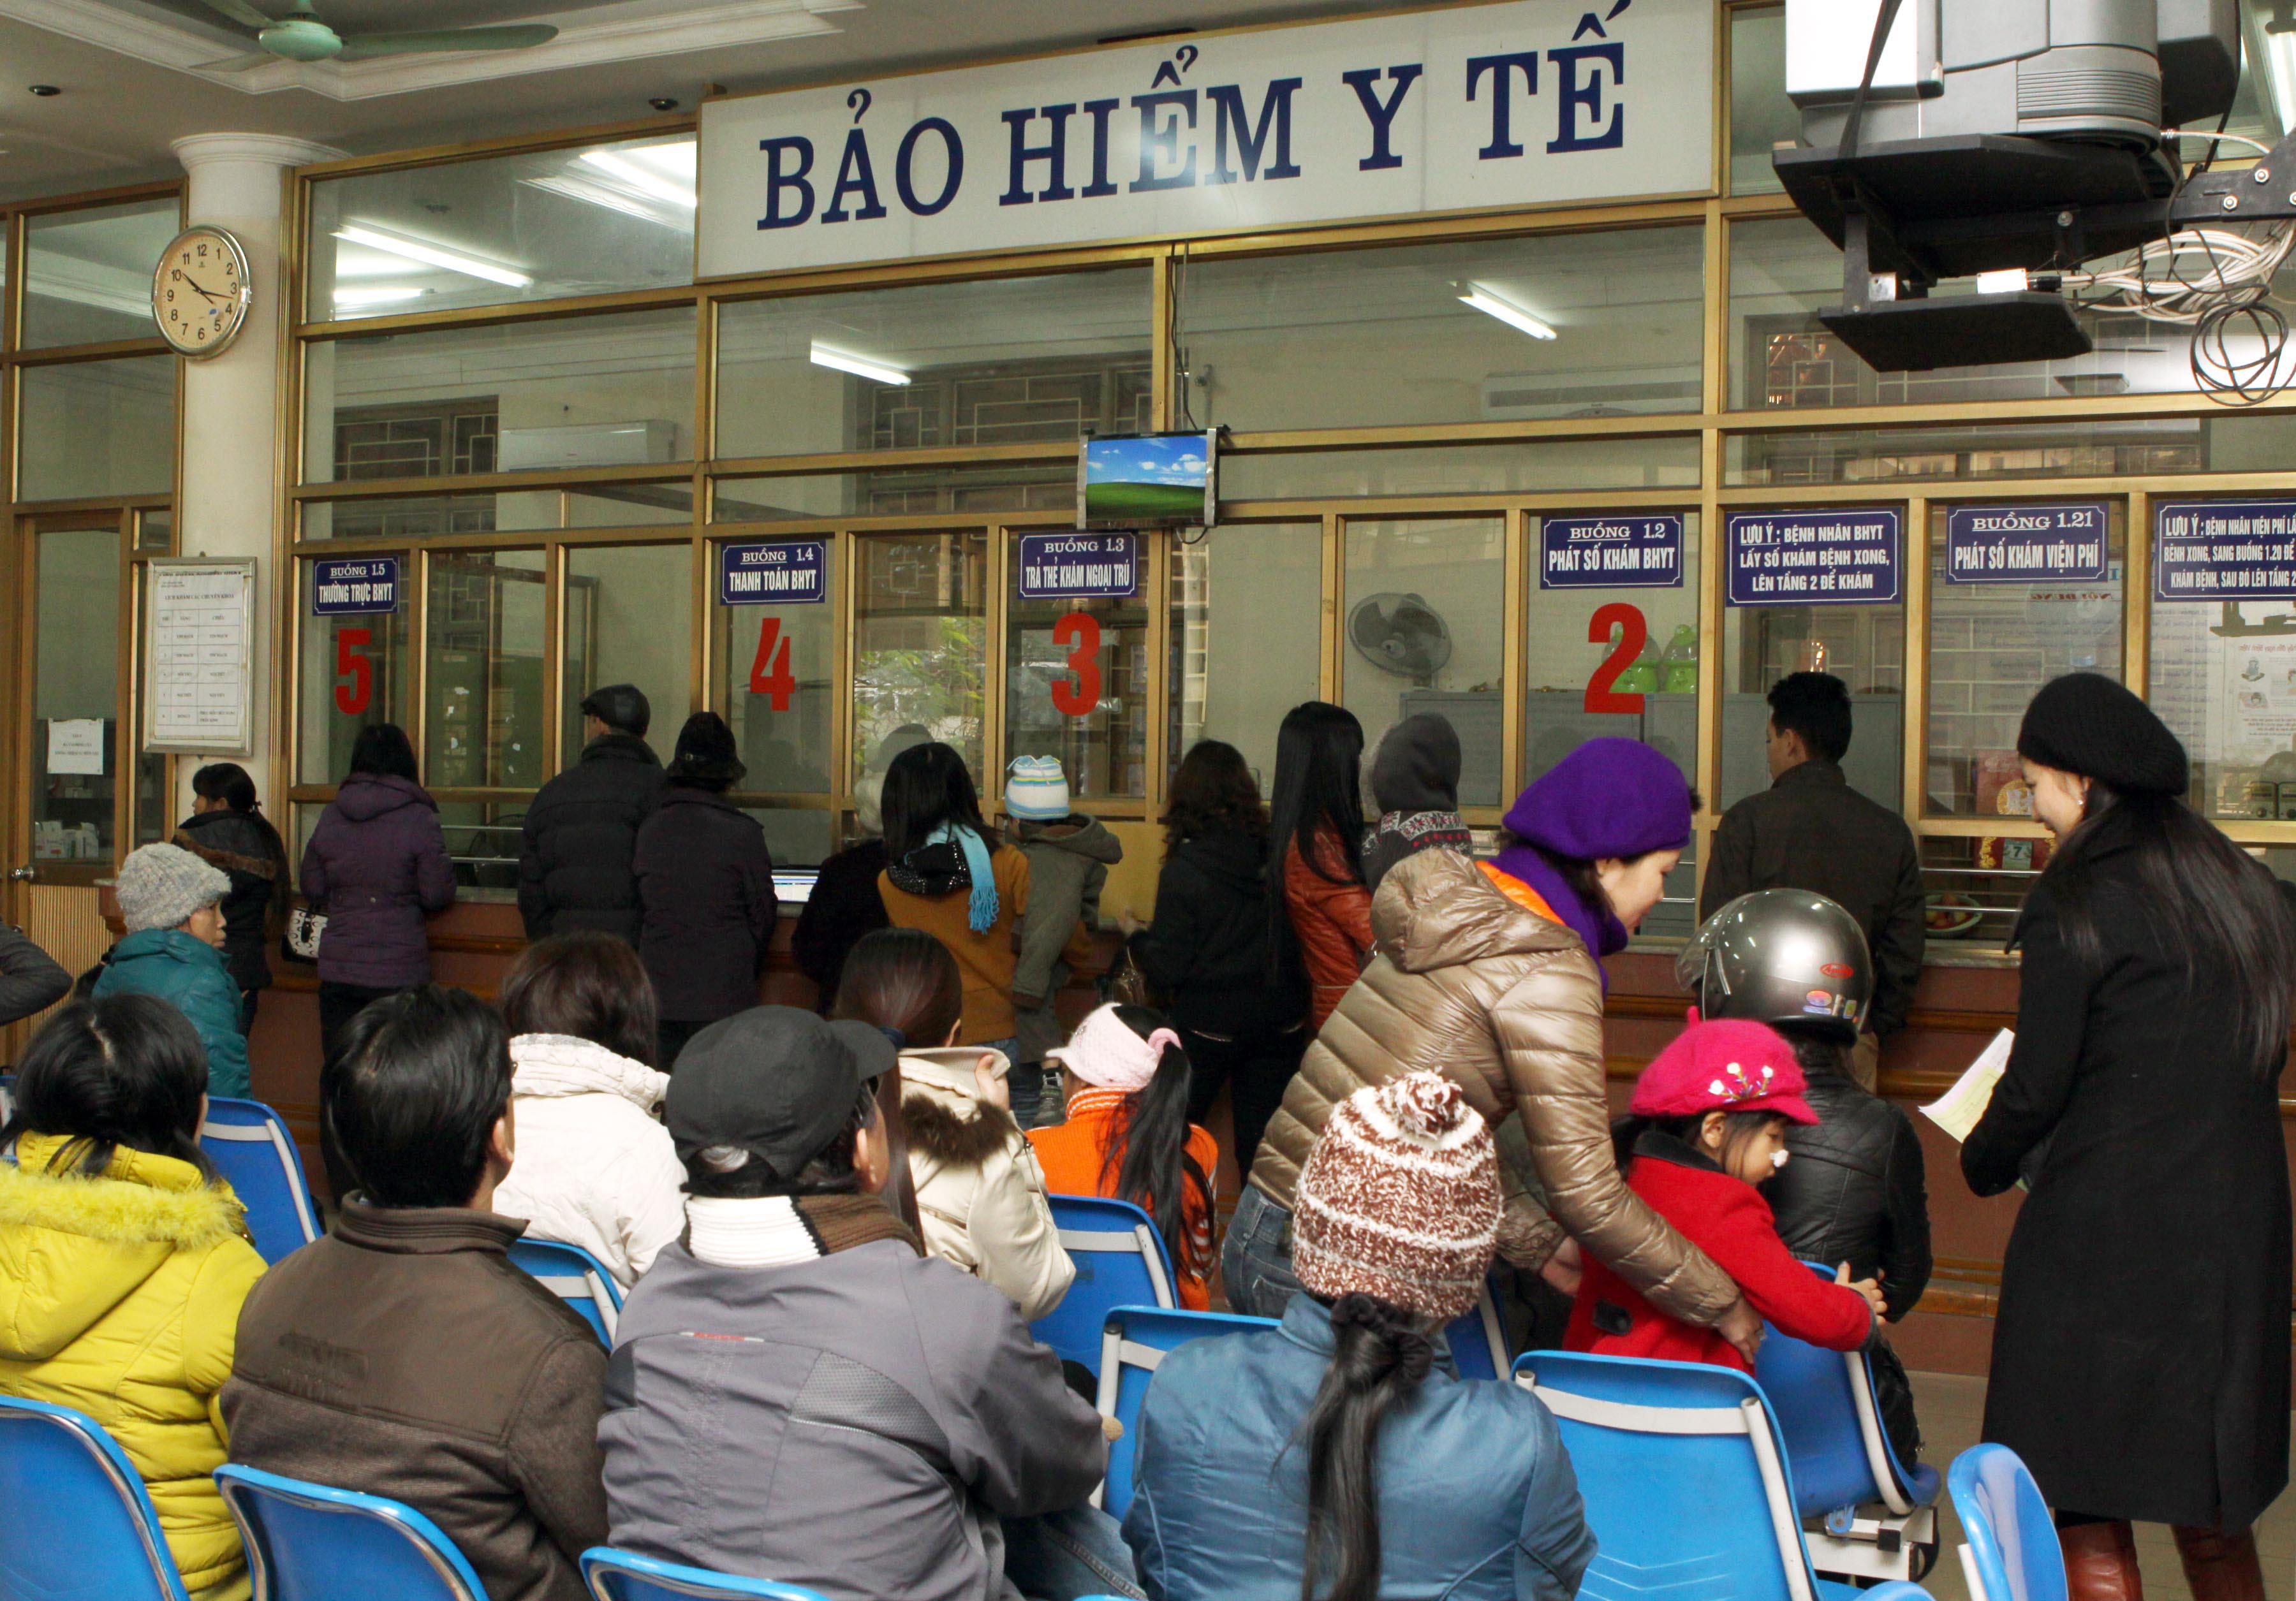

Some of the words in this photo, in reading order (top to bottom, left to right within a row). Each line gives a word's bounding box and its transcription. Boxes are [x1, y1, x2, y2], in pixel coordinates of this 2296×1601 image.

[757, 89, 964, 230] BẢO
[999, 45, 1302, 206] HIỂM
[1343, 63, 1423, 172] Y
[1466, 0, 1631, 160] TẾ
[182, 253, 190, 265] 11
[197, 244, 207, 256] 12
[216, 248, 220, 260] 1
[172, 269, 182, 281] 10
[226, 263, 233, 275] 2
[167, 289, 174, 302] 9
[230, 282, 237, 294] 3
[171, 309, 178, 321] 8
[225, 303, 232, 314] 4
[182, 323, 188, 335] 7
[198, 328, 205, 339] 6
[214, 319, 221, 332] 5
[1972, 511, 2051, 530] BUỒNG
[2057, 511, 2093, 527] 1.21
[2165, 515, 2189, 536] LƯU
[2205, 516, 2226, 539] BỆNH
[2228, 516, 2250, 535] NHÂN
[2252, 515, 2270, 539] VIỆN
[2272, 515, 2286, 534] PHÍ
[1570, 522, 1631, 539] BUỒNG
[1643, 523, 1665, 539] 1.2
[1740, 524, 1763, 545] LƯU
[1784, 525, 1815, 546] BỆNH
[1818, 523, 1851, 542] NHÂN
[1853, 525, 1883, 541] BHYT
[1044, 537, 1099, 553] BUỒNG
[1106, 537, 1124, 552] 1.3
[742, 547, 787, 562] BUỒNG
[797, 547, 814, 562] 1.4
[1549, 545, 1580, 571] PHÁT
[1584, 542, 1601, 571] SỐ
[1603, 544, 1640, 570] KHÁM
[1643, 547, 1675, 569] BHYT
[1740, 548, 1762, 568] LẤY
[1764, 546, 1780, 567] SỐ
[1783, 548, 1816, 567] KHÁM
[1820, 548, 1851, 569] BỆNH
[1853, 549, 1890, 566] XONG,
[1955, 541, 1986, 570] PHÁT
[1989, 537, 2006, 569] SỐ
[2008, 540, 2043, 569] KHÁM
[2047, 539, 2075, 573] VIỆN
[2077, 538, 2099, 567] PHÍ
[2186, 546, 2211, 564] XONG,
[2212, 545, 2235, 561] SANG
[2265, 545, 2282, 560] 1.20
[330, 563, 367, 576] BUỒNG
[372, 564, 385, 576] 1.5
[1026, 557, 1041, 588] TRẢ
[1043, 556, 1058, 588] THẺ
[1060, 560, 1084, 587] KHÁM
[1086, 564, 1112, 592] NGOẠI
[1114, 559, 1130, 587] TRÚ
[730, 571, 761, 592] THANH
[763, 567, 789, 591] TOÁN
[791, 569, 816, 590] BHYT
[1753, 574, 1774, 592] LÊN
[1777, 571, 1807, 591] TẦNG
[1810, 575, 1818, 590] 2
[1820, 569, 1836, 590] ĐỂ
[1839, 571, 1873, 589] KHÁM
[2171, 569, 2194, 588] KHÁM
[2196, 569, 2219, 591] BỆNH,
[2221, 571, 2237, 587] SAU
[2239, 567, 2250, 587] ĐÓ
[2251, 567, 2267, 587] LÊN
[2291, 571, 2296, 587] 2
[319, 580, 350, 603] THƯỜNG
[351, 582, 371, 606] TRỰC
[372, 583, 393, 601] BHYT
[750, 618, 795, 711] 4
[1052, 613, 1100, 716] 3
[1584, 602, 1647, 714] 2
[335, 629, 372, 715] 5
[2013, 846, 2022, 858] 7
